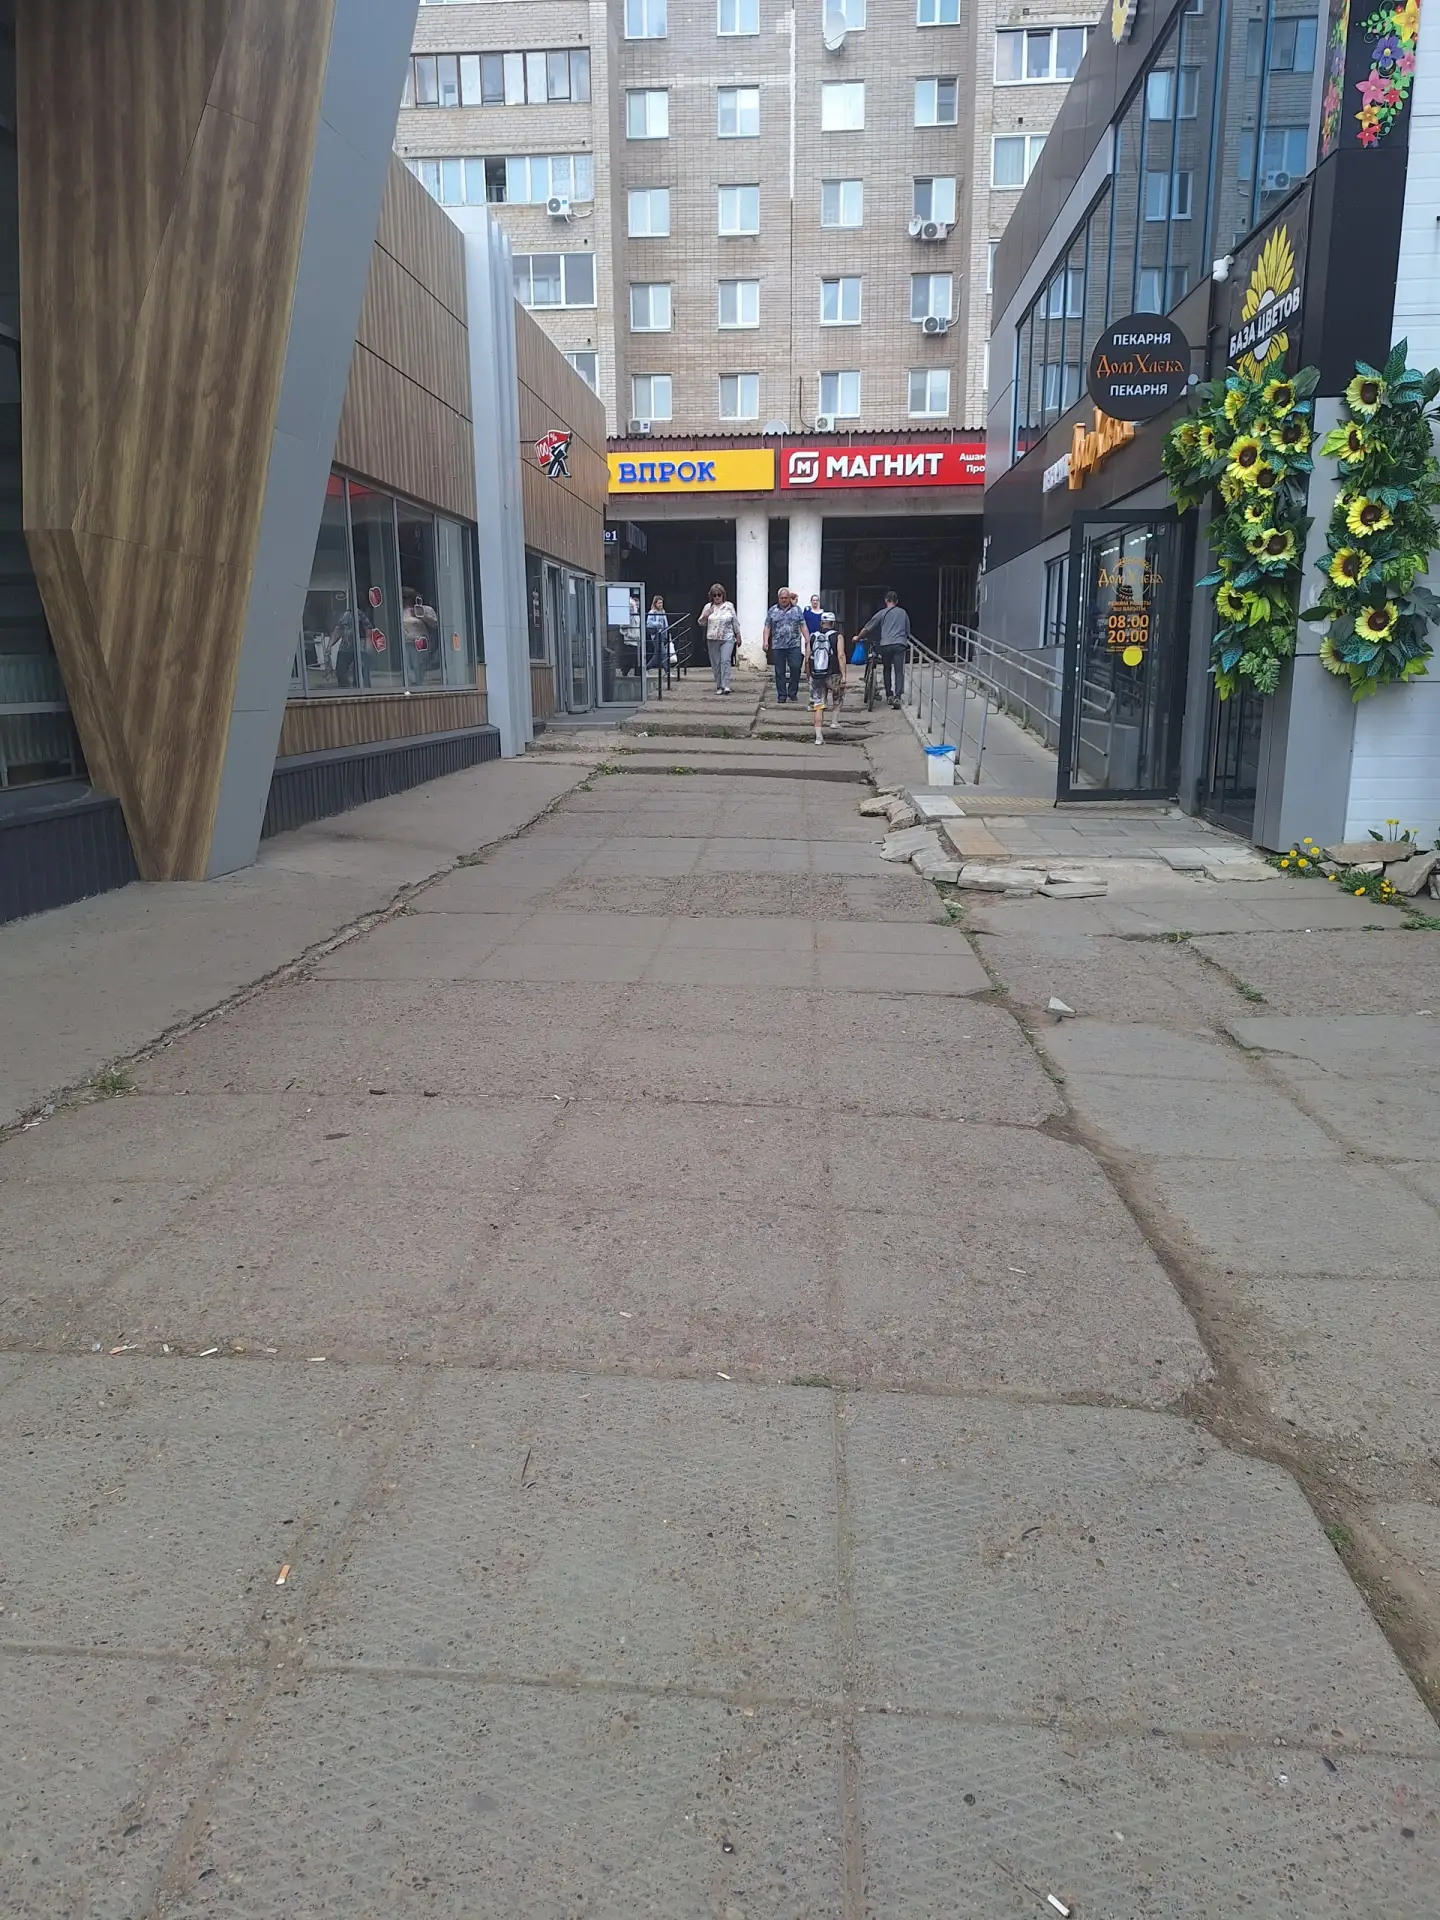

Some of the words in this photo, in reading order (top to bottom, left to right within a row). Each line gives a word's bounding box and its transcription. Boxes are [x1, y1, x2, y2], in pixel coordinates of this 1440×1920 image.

[1229, 321, 1255, 358] БАЗА
[1257, 286, 1300, 339] ЦВЕТОВ
[1113, 333, 1171, 345] ПЕКАРНЯ
[1097, 354, 1133, 378] Дом
[1110, 384, 1168, 396] ПЕКАРНЯ
[618, 461, 716, 483] ВПРОК
[826, 452, 943, 478] МАГНИТ
[1108, 615, 1149, 628] 08:00
[1107, 630, 1148, 643] 20:00
